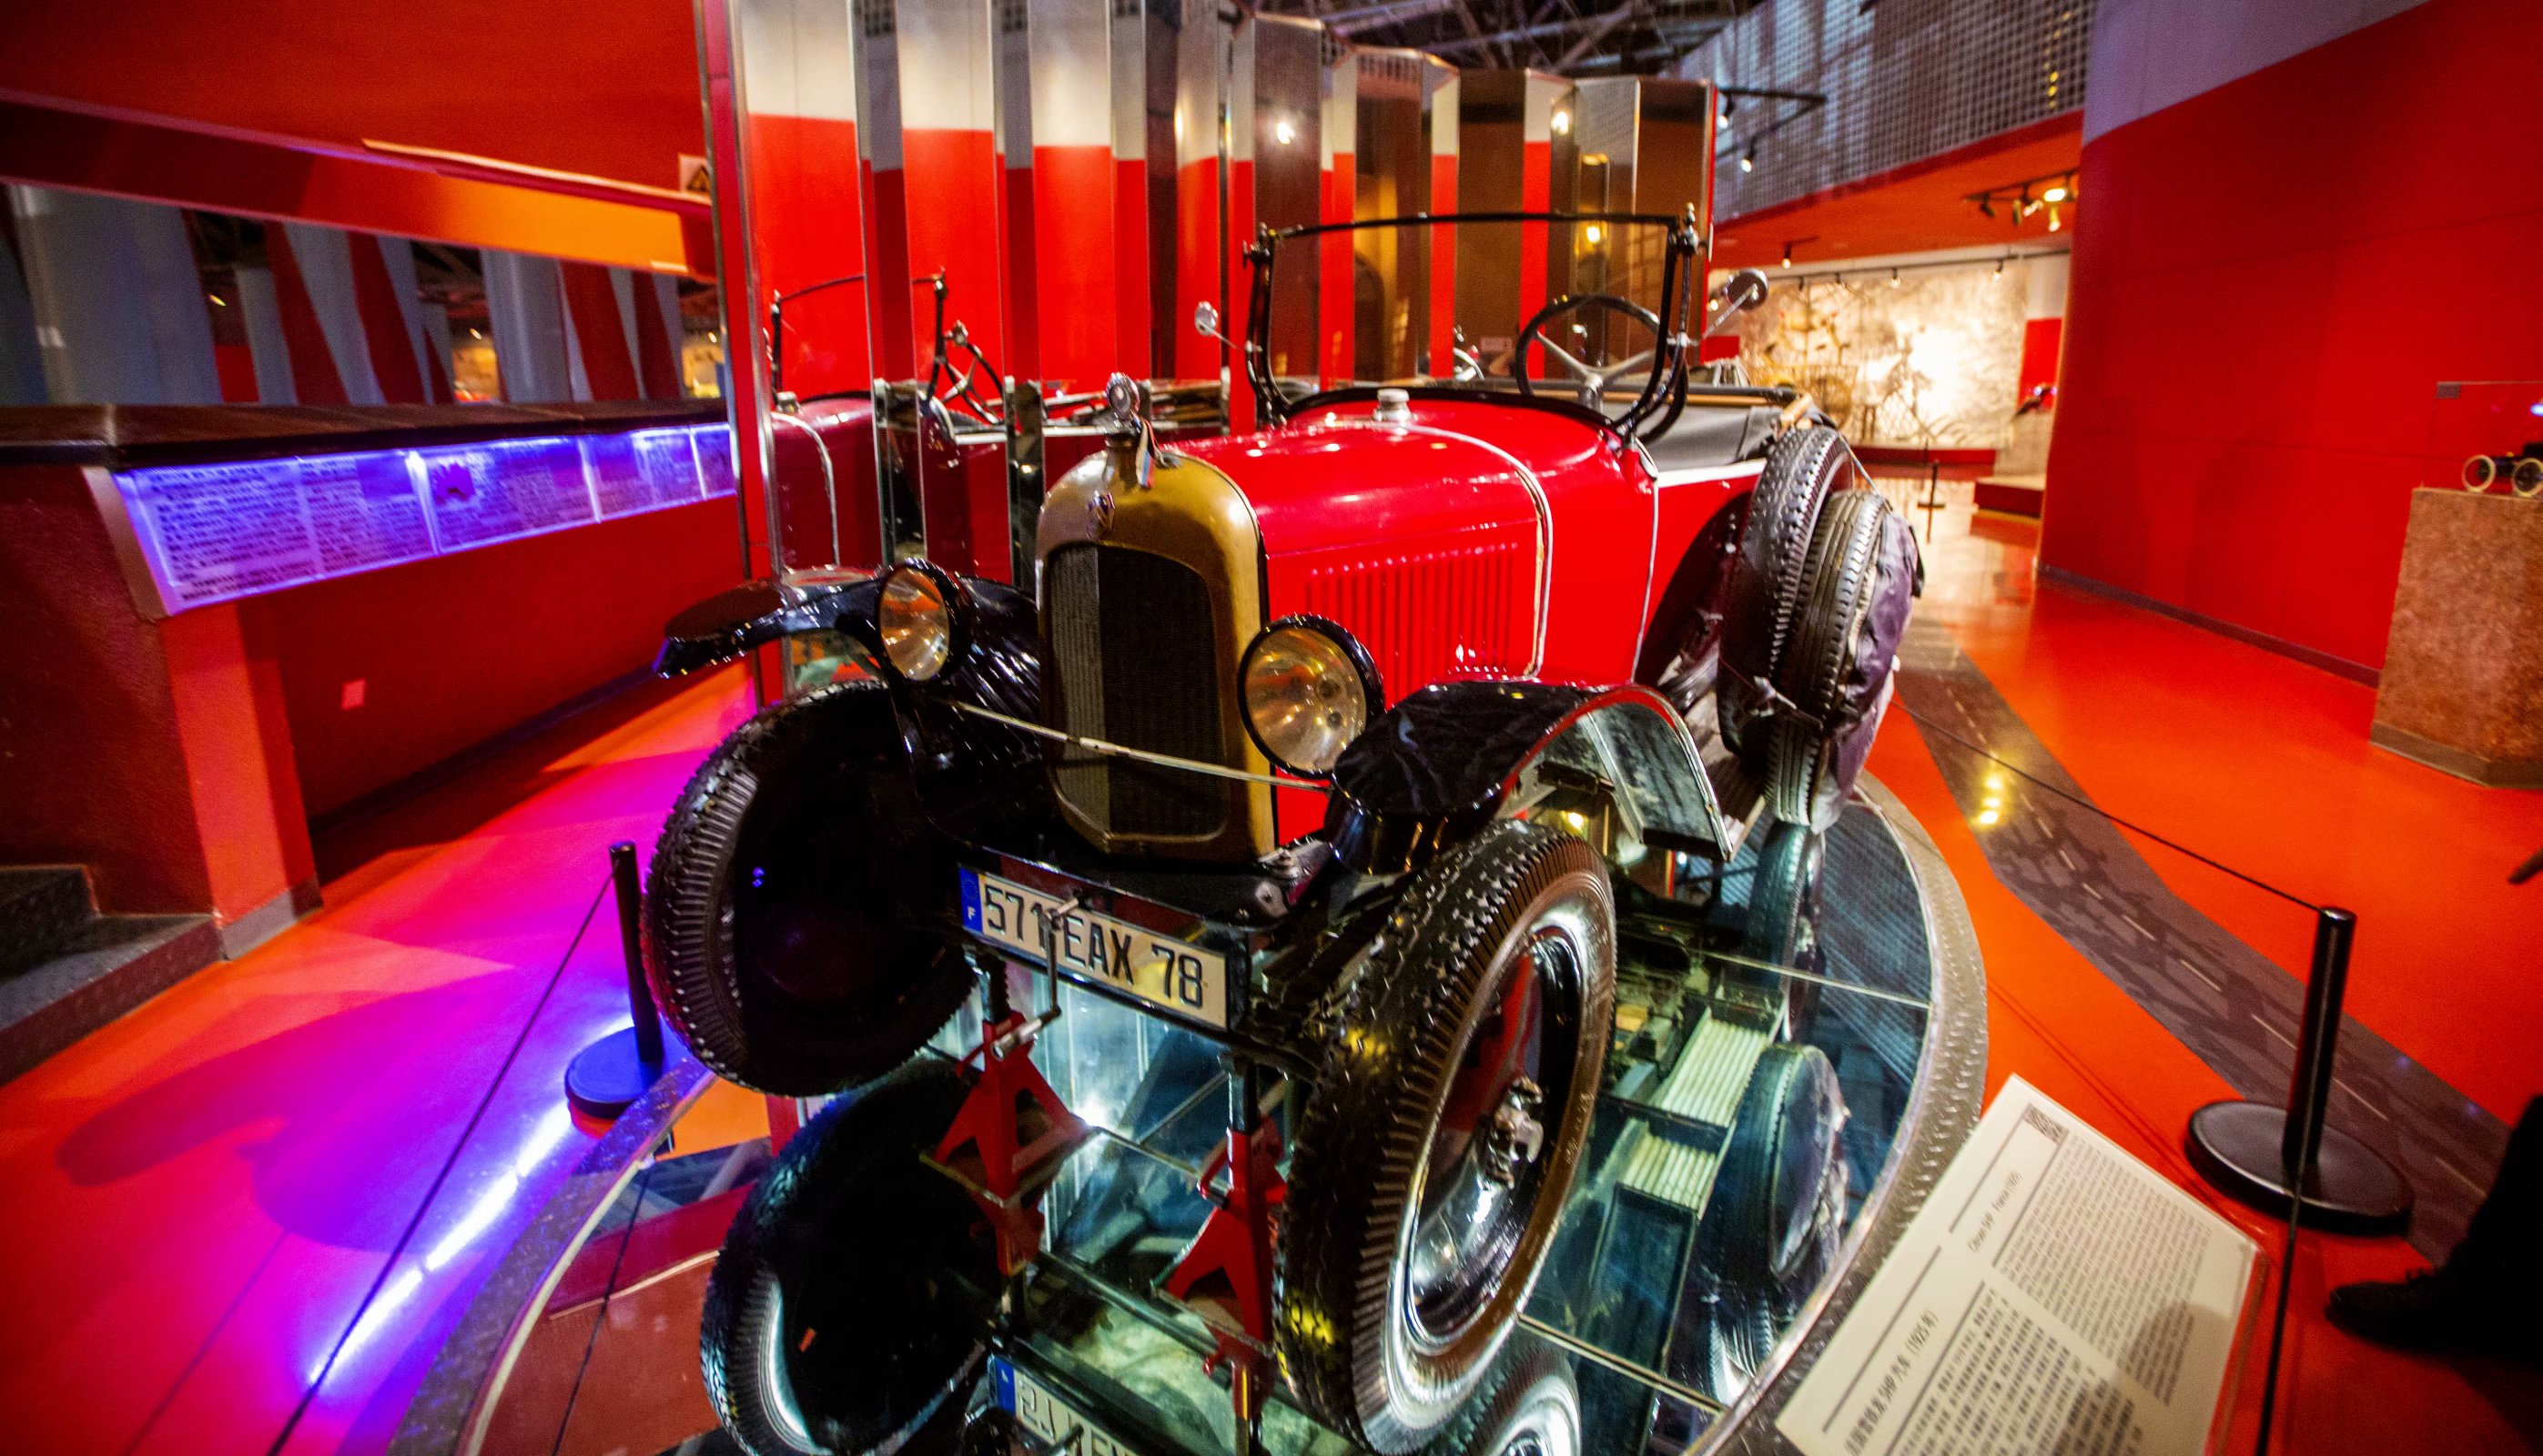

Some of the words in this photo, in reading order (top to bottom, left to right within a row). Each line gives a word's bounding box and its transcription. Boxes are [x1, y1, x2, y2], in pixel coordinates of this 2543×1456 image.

[968, 906, 976, 920] F
[984, 884, 1046, 954] 571
[1063, 915, 1134, 986] EAX
[1151, 943, 1203, 1009] 78
